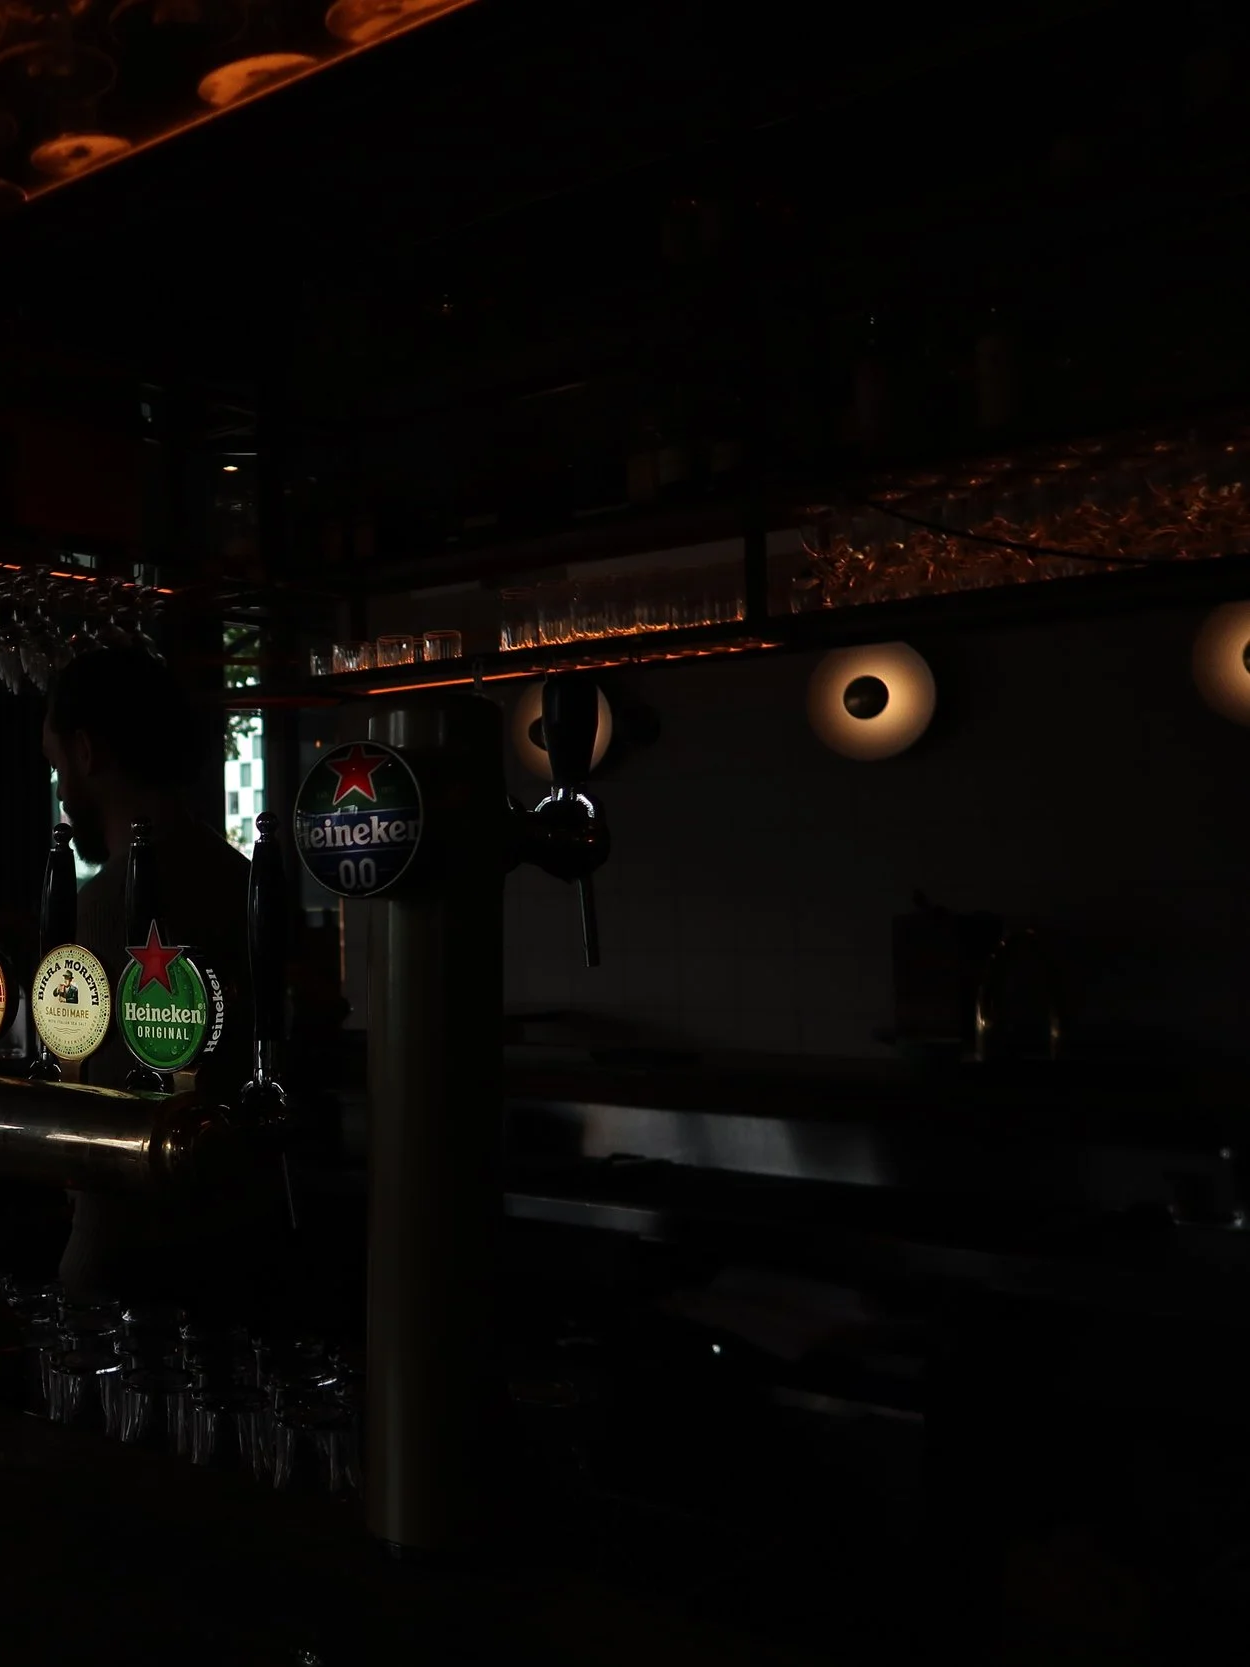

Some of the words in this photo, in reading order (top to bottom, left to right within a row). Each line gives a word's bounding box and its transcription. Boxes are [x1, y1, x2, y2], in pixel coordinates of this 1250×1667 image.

[38, 962, 61, 1001] BIRRA
[64, 959, 100, 1006] MORETTI
[45, 1007, 61, 1017] SALE
[61, 1008, 70, 1018] DI
[70, 1009, 90, 1019] MARE
[125, 1002, 202, 1025] Heineken
[203, 968, 225, 1053] Heineken
[137, 1025, 190, 1041] ORIGINAL
